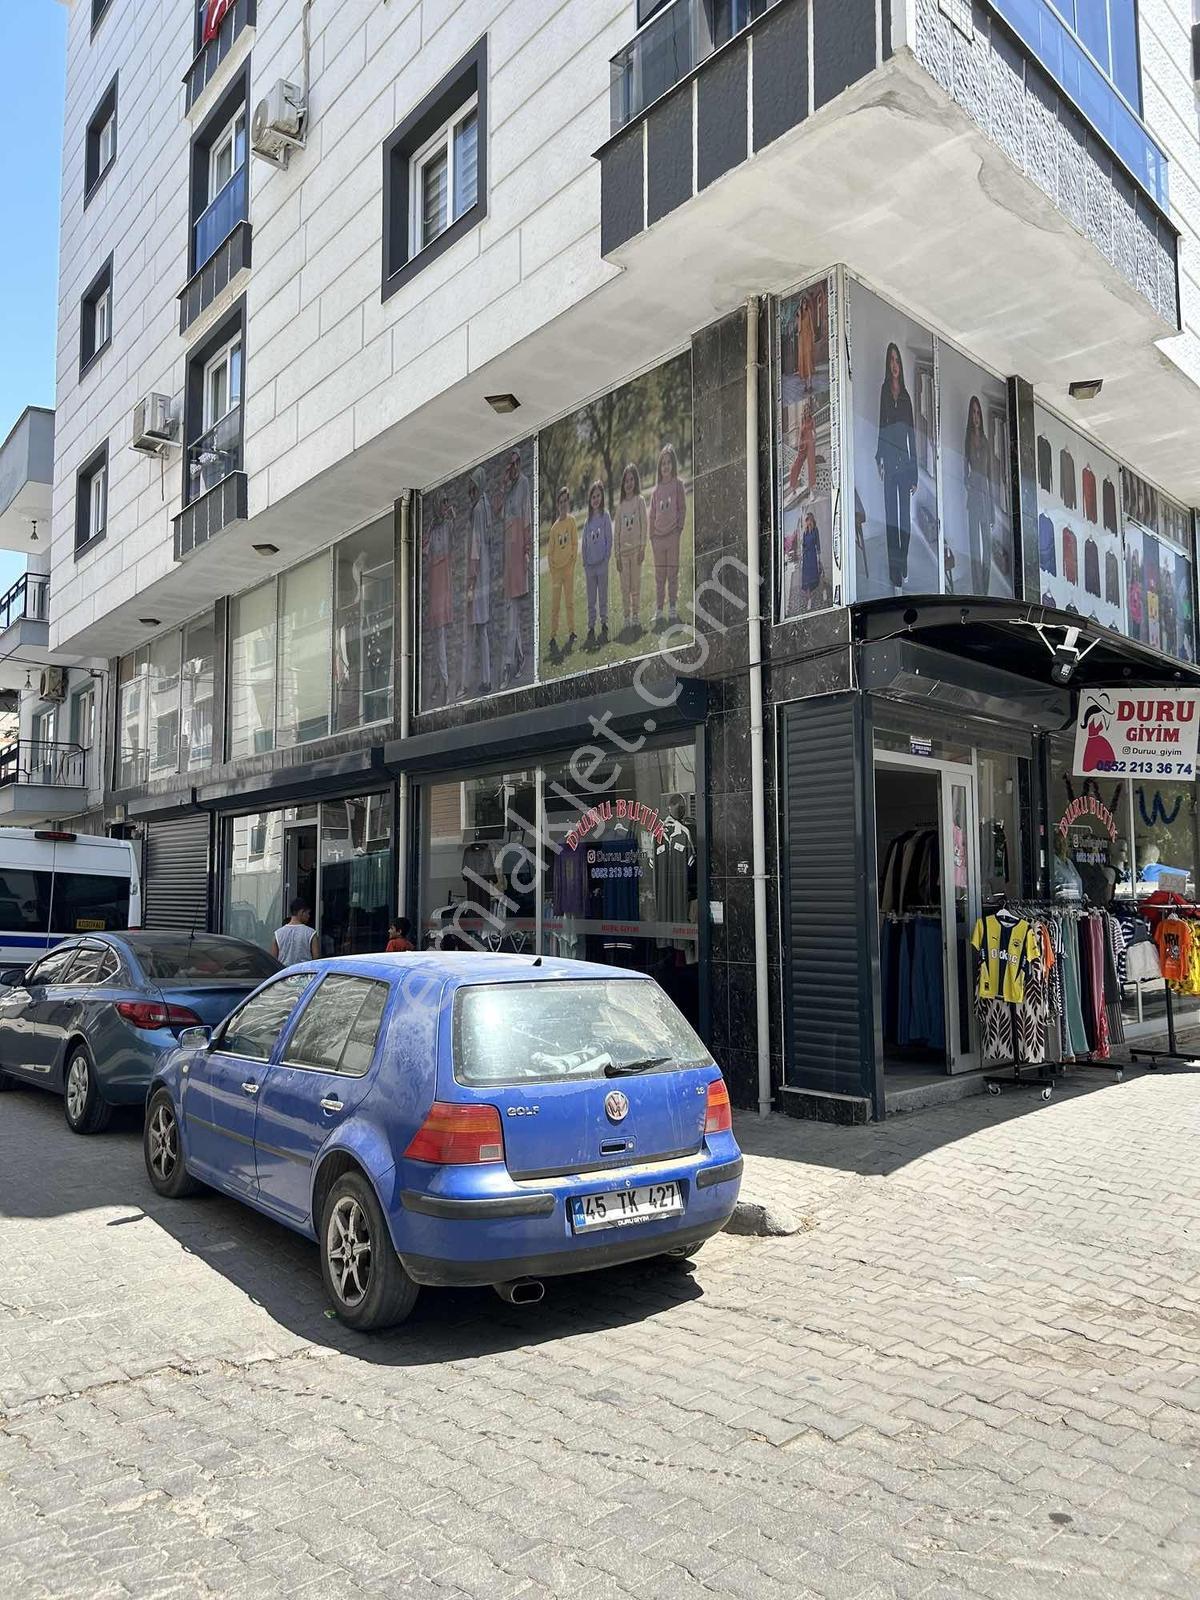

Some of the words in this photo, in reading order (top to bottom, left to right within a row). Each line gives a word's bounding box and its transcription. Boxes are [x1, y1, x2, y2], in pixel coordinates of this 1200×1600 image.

[1116, 700, 1196, 722] DURU
[1126, 724, 1180, 742] GİYİM
[1132, 747, 1182, 757] Duruu_giyim
[1096, 760, 1126, 773] 0552
[1129, 761, 1153, 773] 213
[1156, 762, 1173, 774] 36
[1176, 763, 1193, 775] 74
[566, 800, 613, 851] DURU
[616, 799, 667, 844] BUTİK
[506, 1105, 540, 1117] GOLF
[586, 1195, 607, 1220] 45
[617, 1190, 639, 1215] TK
[648, 1184, 675, 1209] 427
